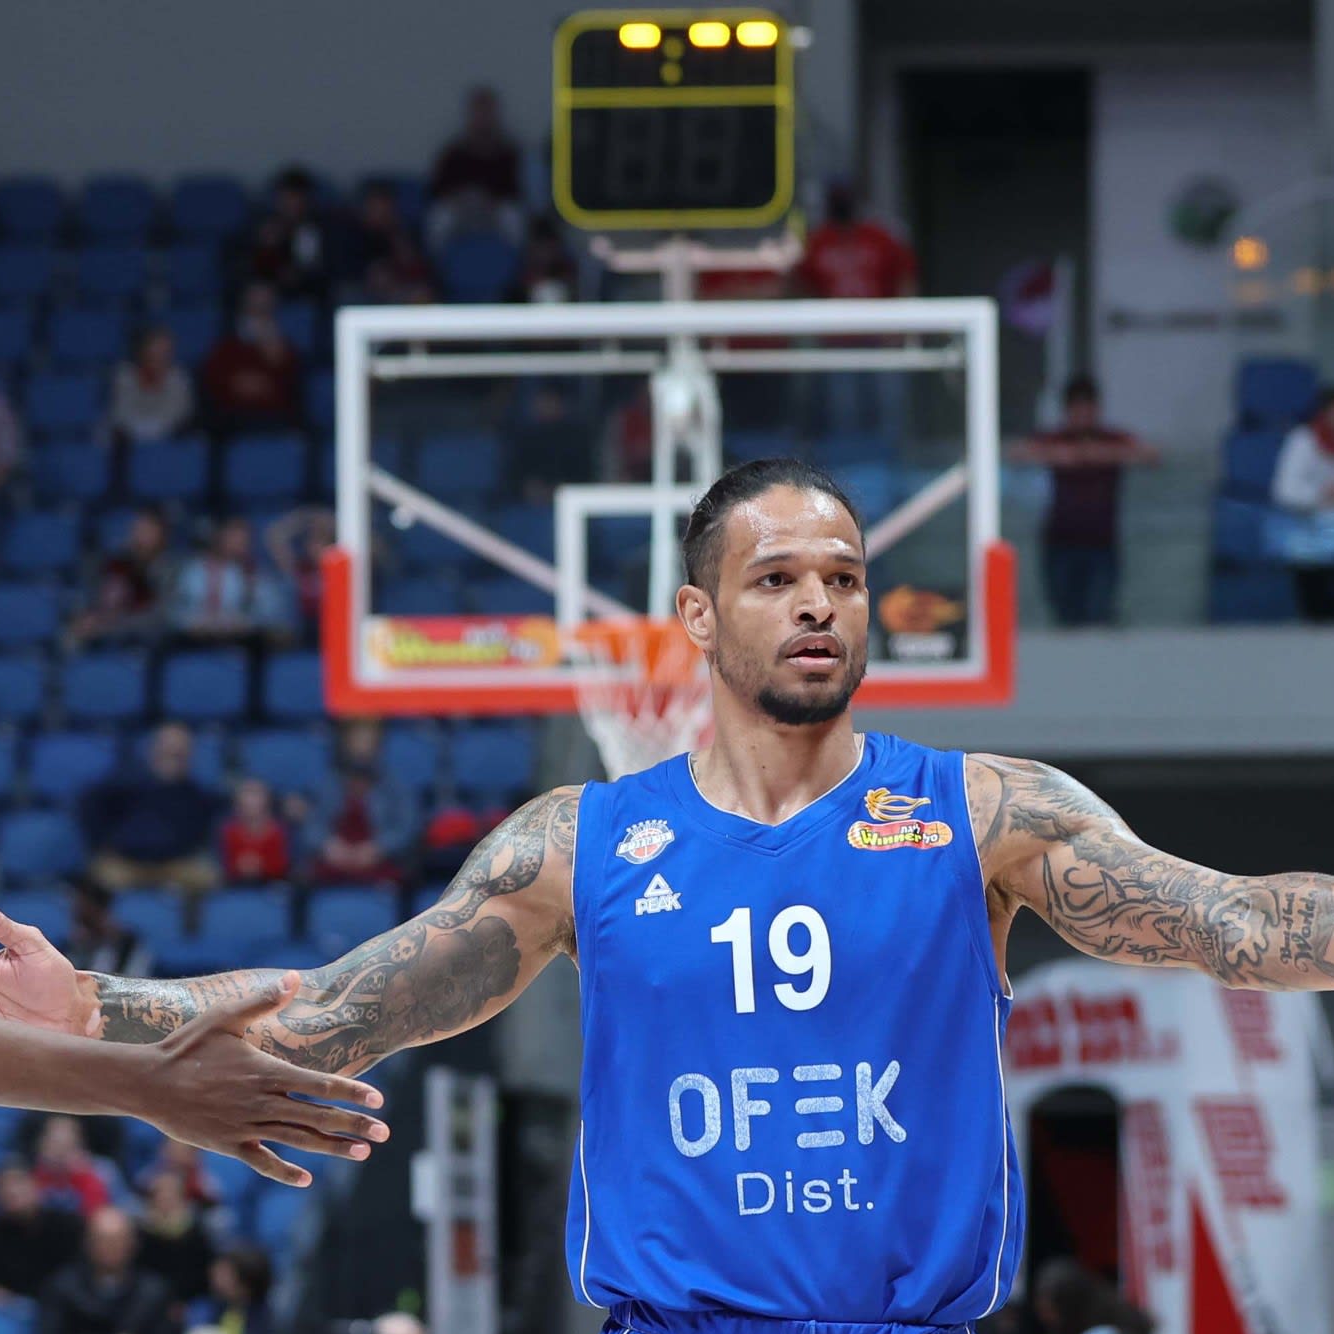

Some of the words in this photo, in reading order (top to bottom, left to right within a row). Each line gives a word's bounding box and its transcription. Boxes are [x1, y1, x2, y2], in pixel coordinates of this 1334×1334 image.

[635, 892, 682, 916] PEAK
[710, 904, 832, 1014] 19
[668, 1060, 907, 1158] OFEK
[736, 1168, 874, 1216] Dist.
